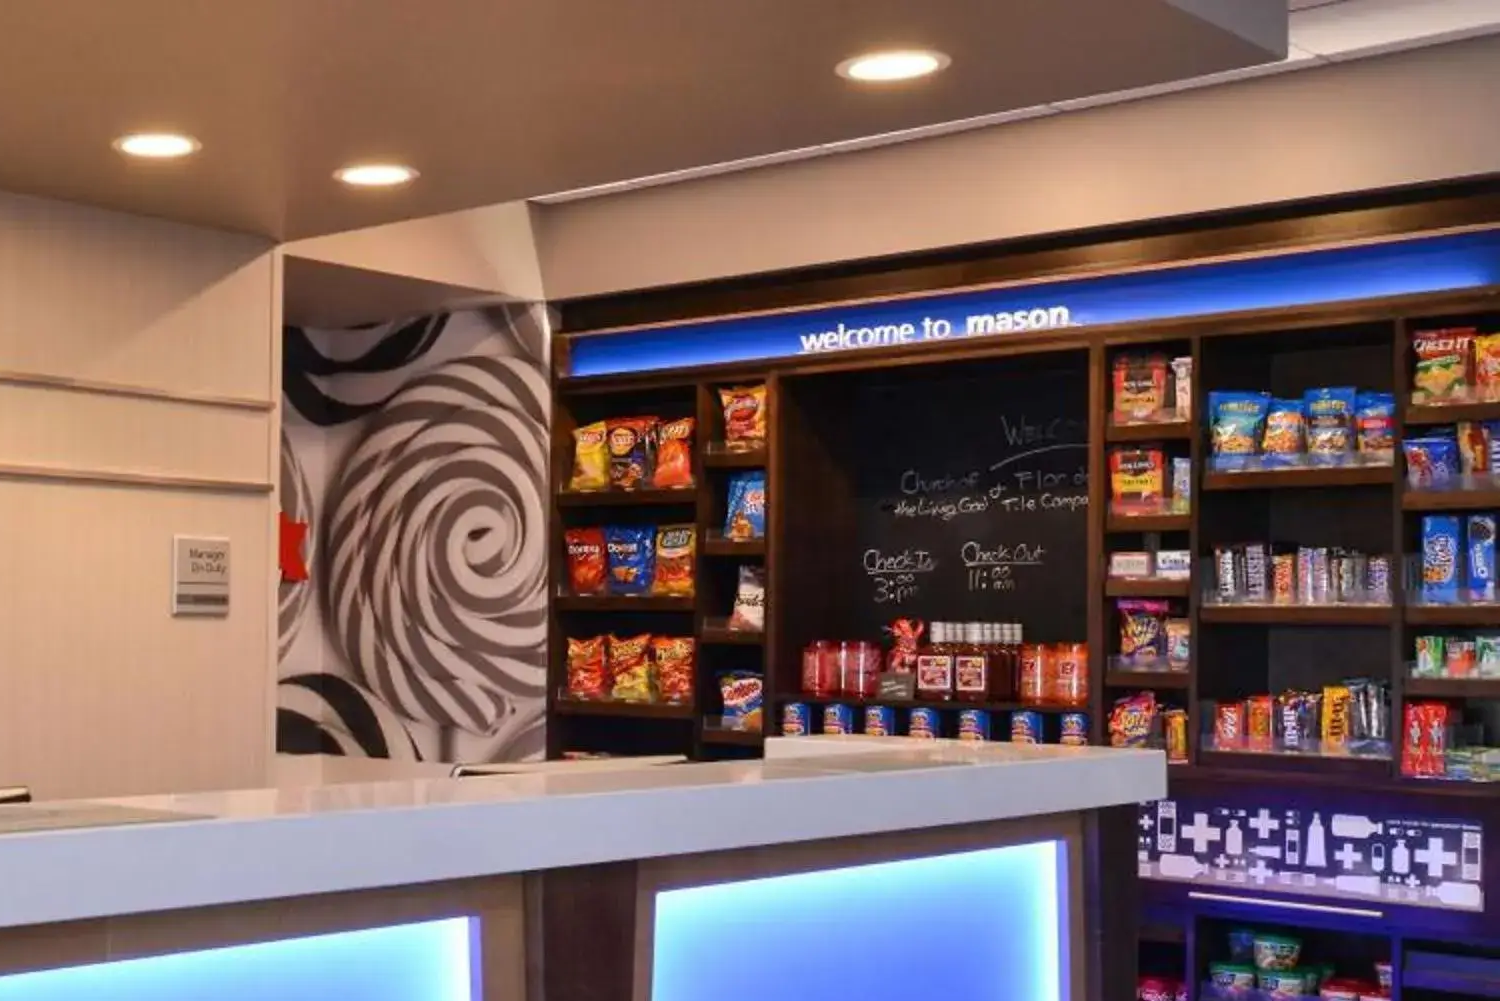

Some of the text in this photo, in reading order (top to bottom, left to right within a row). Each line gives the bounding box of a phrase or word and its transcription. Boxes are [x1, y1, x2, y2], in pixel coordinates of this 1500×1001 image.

[800, 306, 1070, 351] welcome to mason
[863, 549, 913, 571] Check
[962, 541, 1046, 563] Check Out
